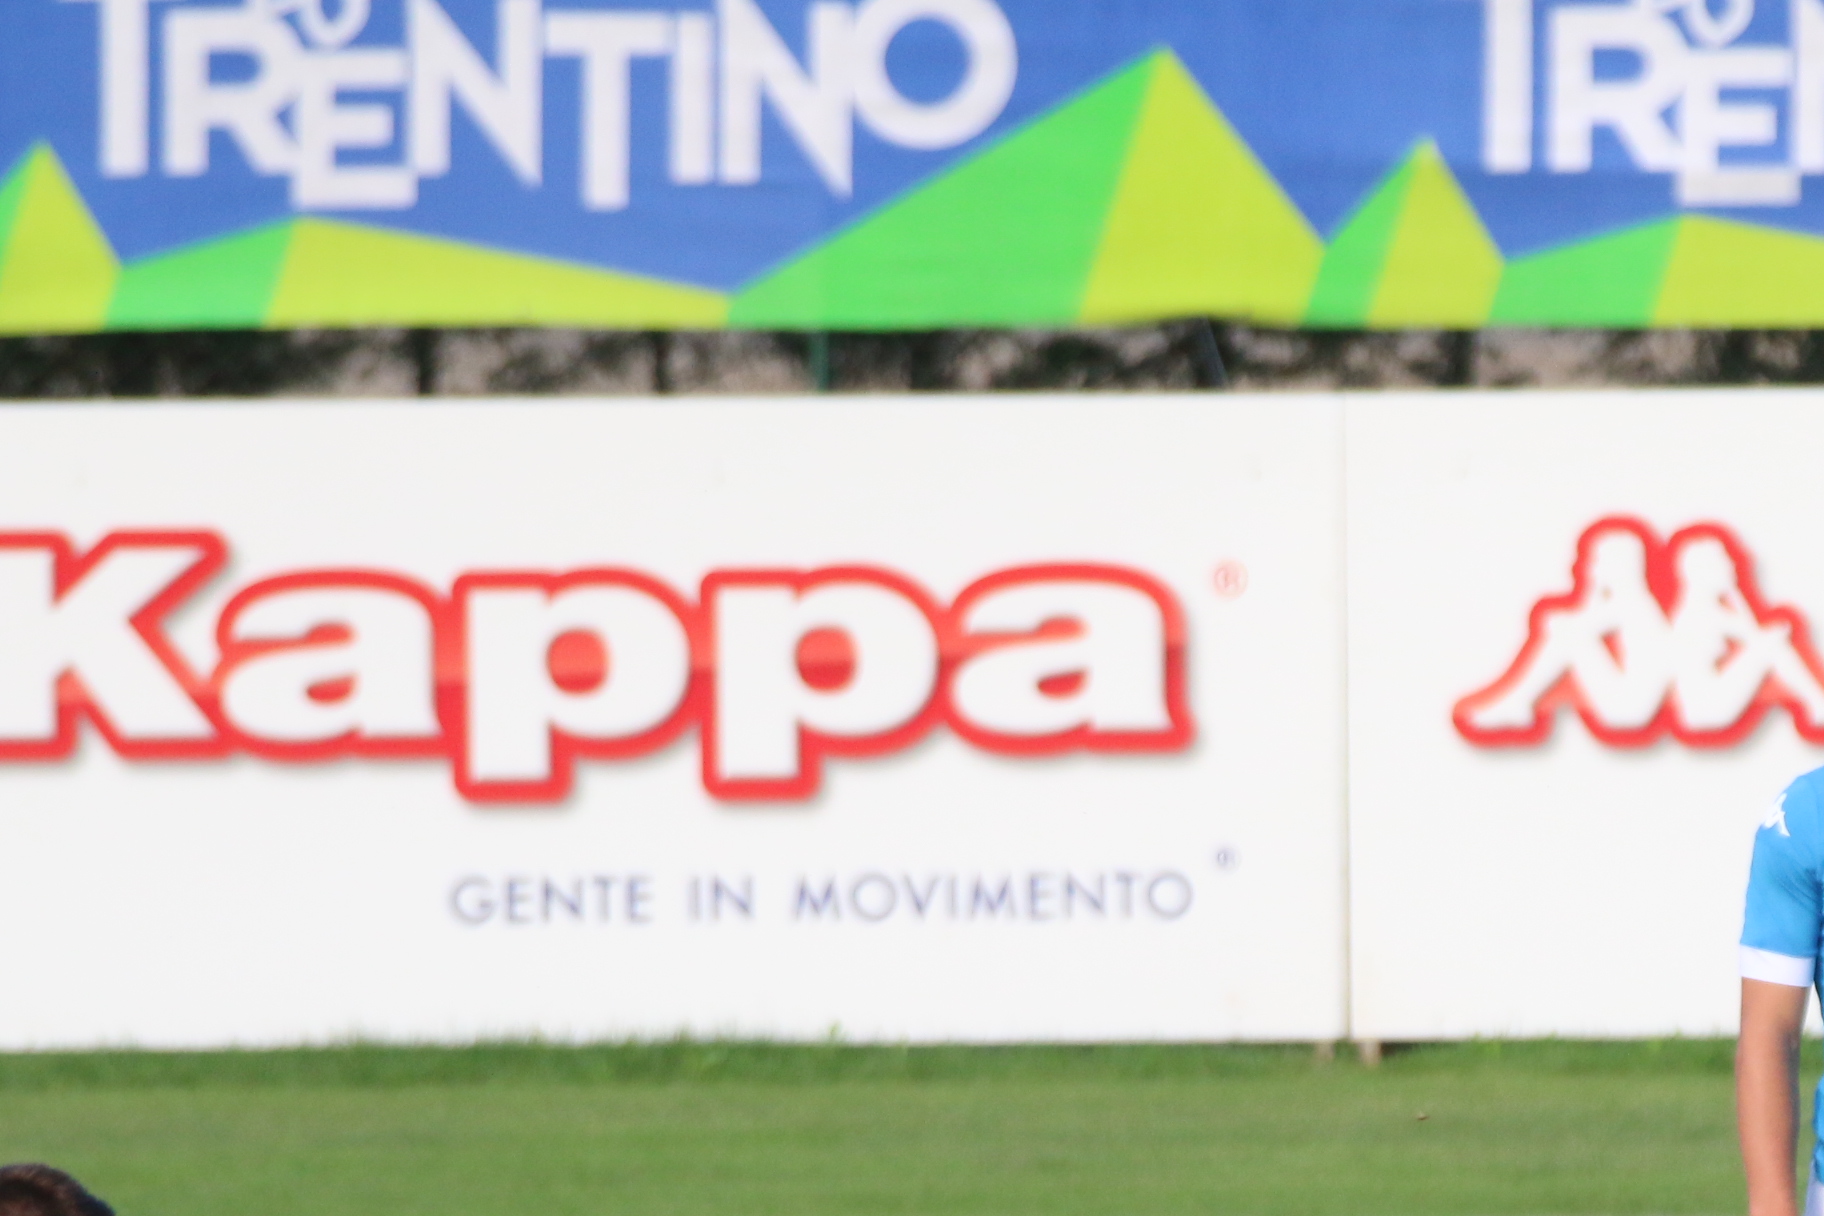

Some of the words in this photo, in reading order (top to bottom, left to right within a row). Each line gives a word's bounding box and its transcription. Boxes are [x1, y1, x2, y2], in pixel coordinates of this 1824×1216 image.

[0, 529, 1196, 804] Kappa
[446, 874, 651, 927] GENTE
[687, 874, 755, 921] IN
[790, 870, 1194, 923] MOVIMENTO
